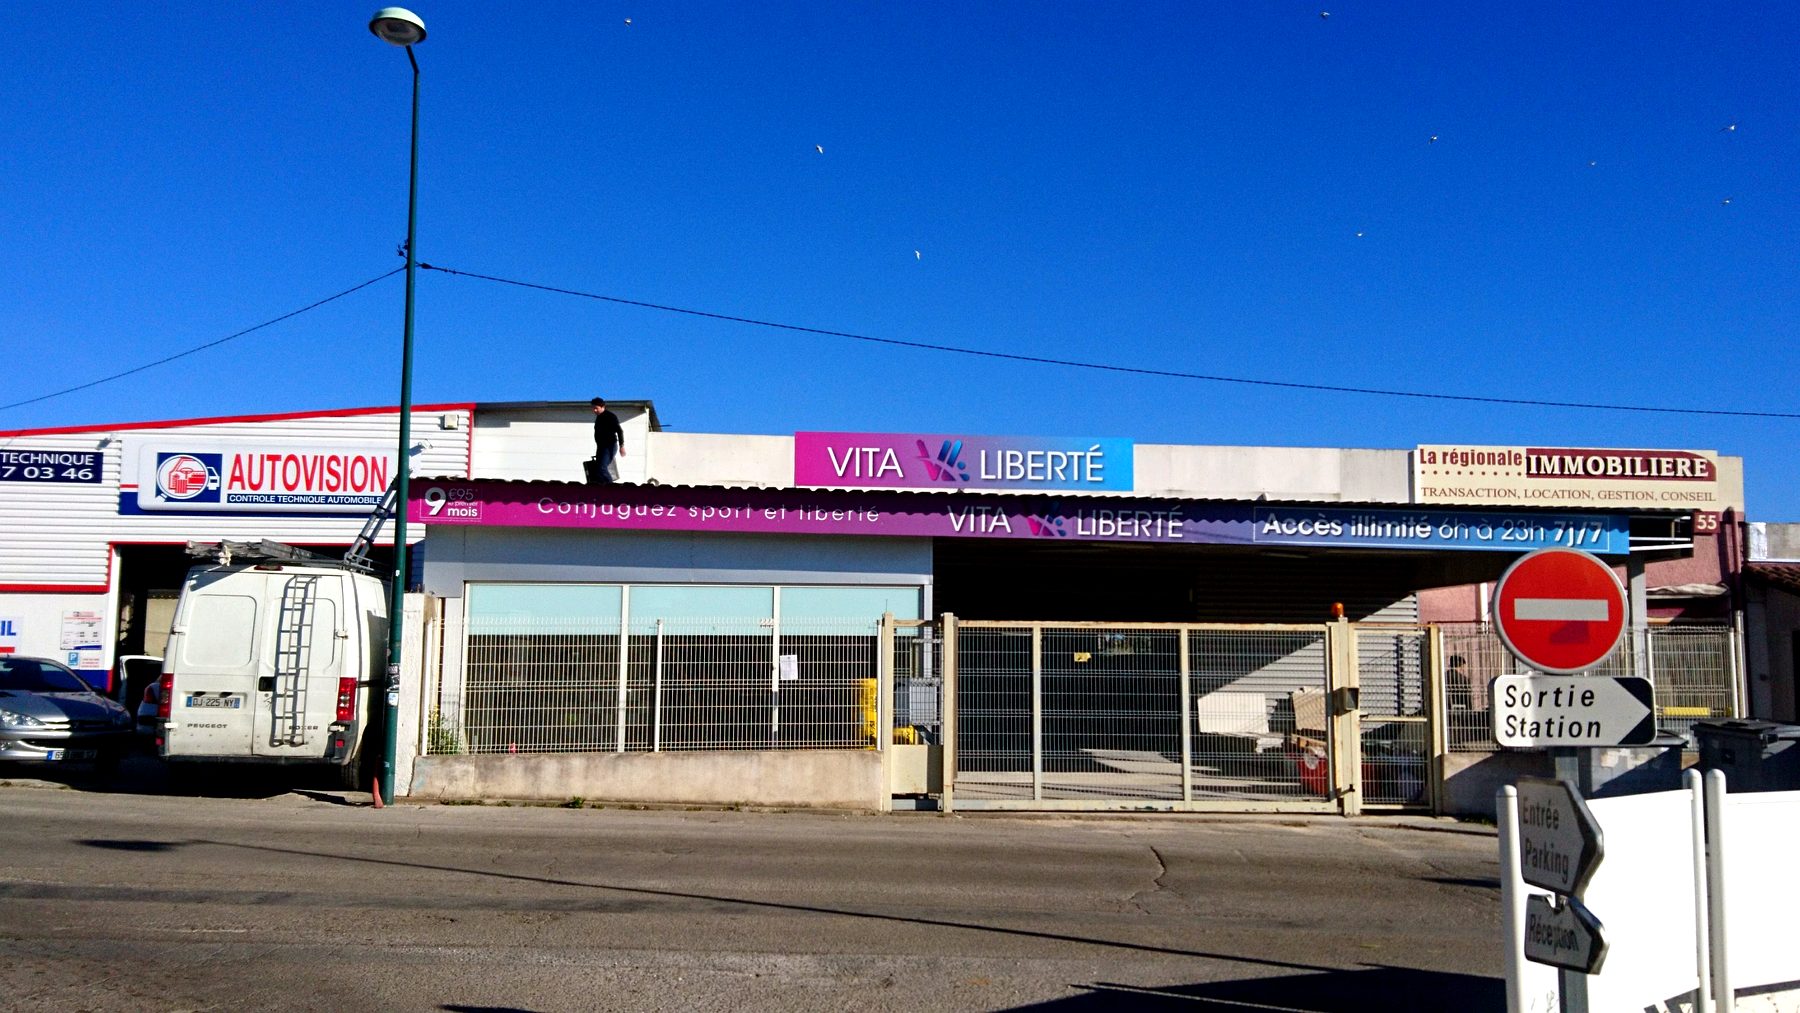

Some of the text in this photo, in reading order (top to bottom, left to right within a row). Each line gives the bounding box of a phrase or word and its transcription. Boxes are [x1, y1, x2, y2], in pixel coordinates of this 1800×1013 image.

[0, 452, 94, 466] TECHNIQUE
[827, 444, 1104, 481] VITA LIBERTÉ
[1420, 448, 1709, 477] La régionale IMMOBILIERE
[2, 466, 94, 480] 7 03 46
[227, 453, 388, 492] AUTOVISION
[229, 495, 276, 503] CONTROLE
[277, 495, 325, 504] TECHNIQUE
[425, 487, 447, 516] 9
[1421, 486, 1717, 502] TRANSACTION, LOCATION, GESTION, CONSEIL
[447, 507, 478, 517] mois
[537, 497, 880, 522] Conjuguez sport et liberté
[947, 505, 1184, 538] VITA LIBERTÉ
[1262, 512, 1603, 547] Accès illimité 6h à 23h 7j/7
[1697, 515, 1717, 530] 55
[1504, 685, 1596, 709] Sortie
[1504, 714, 1602, 739] Station
[1522, 798, 1560, 831] Entrée
[1525, 836, 1569, 884] Parking
